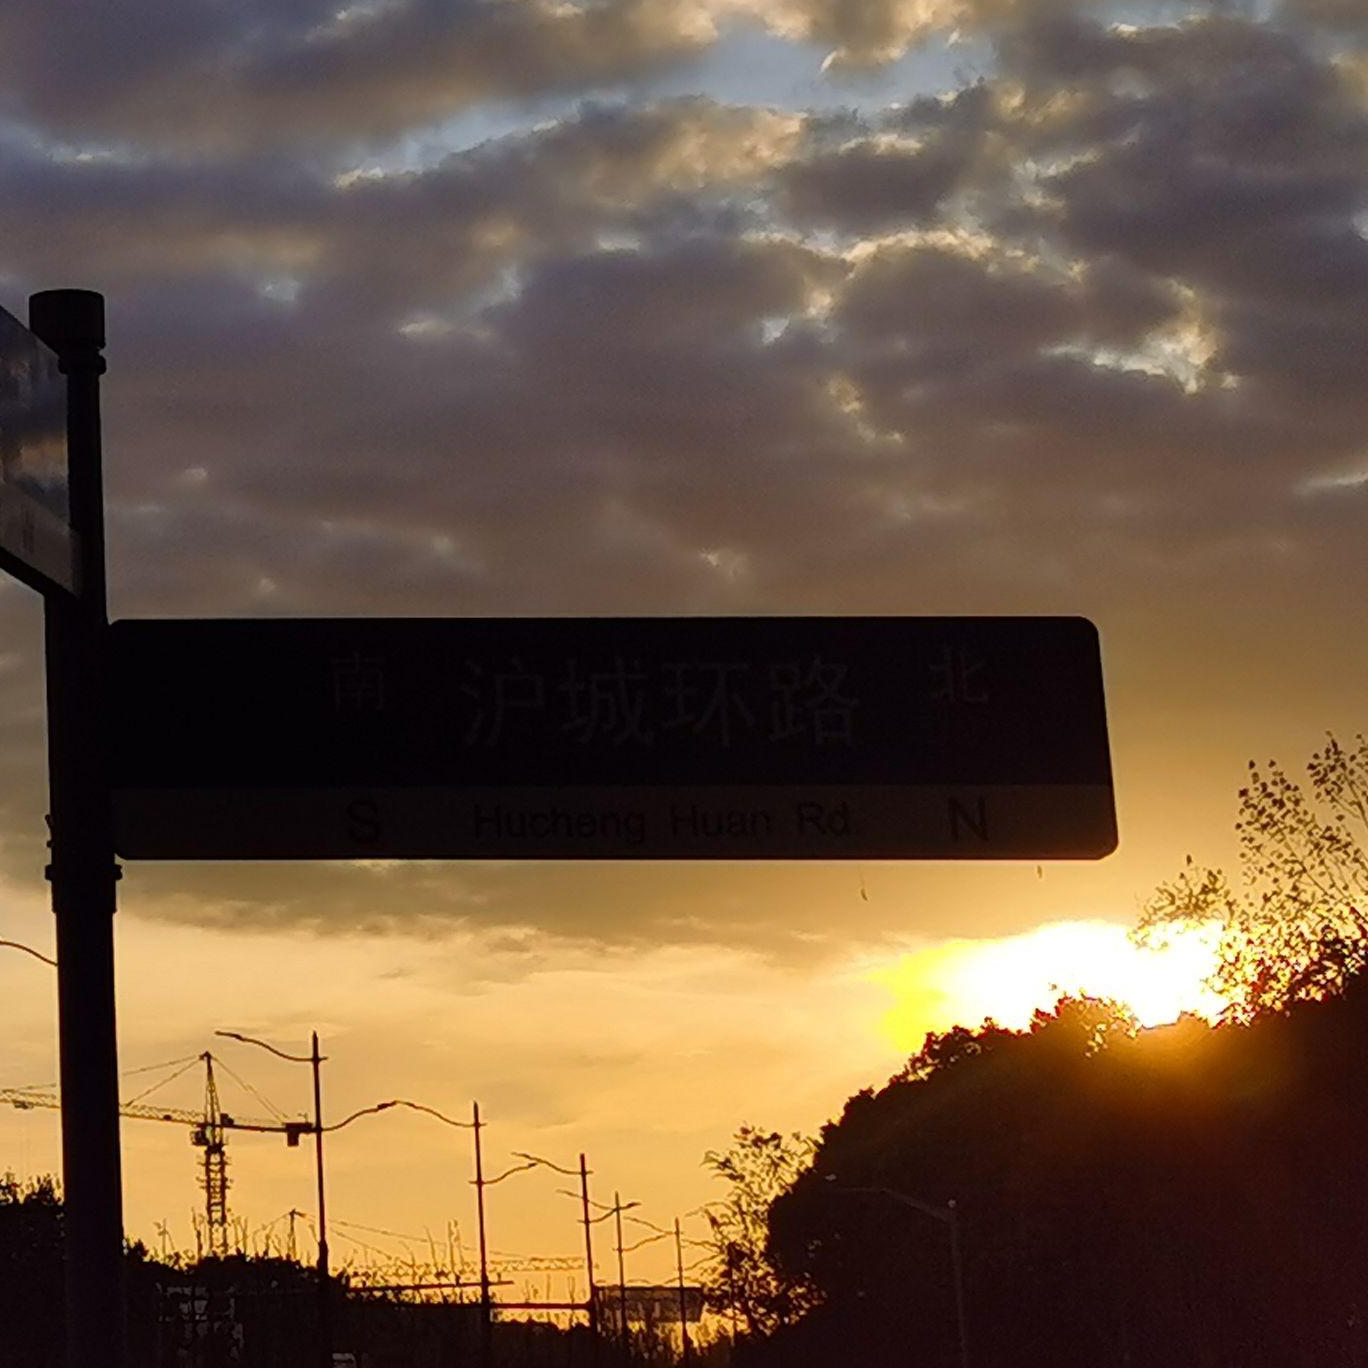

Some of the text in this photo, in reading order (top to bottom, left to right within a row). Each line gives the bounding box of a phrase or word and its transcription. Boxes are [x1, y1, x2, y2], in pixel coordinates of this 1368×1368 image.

[331, 643, 989, 746] 南 沪城环路 北
[345, 795, 989, 845] S Hucheng Huan Rd N
